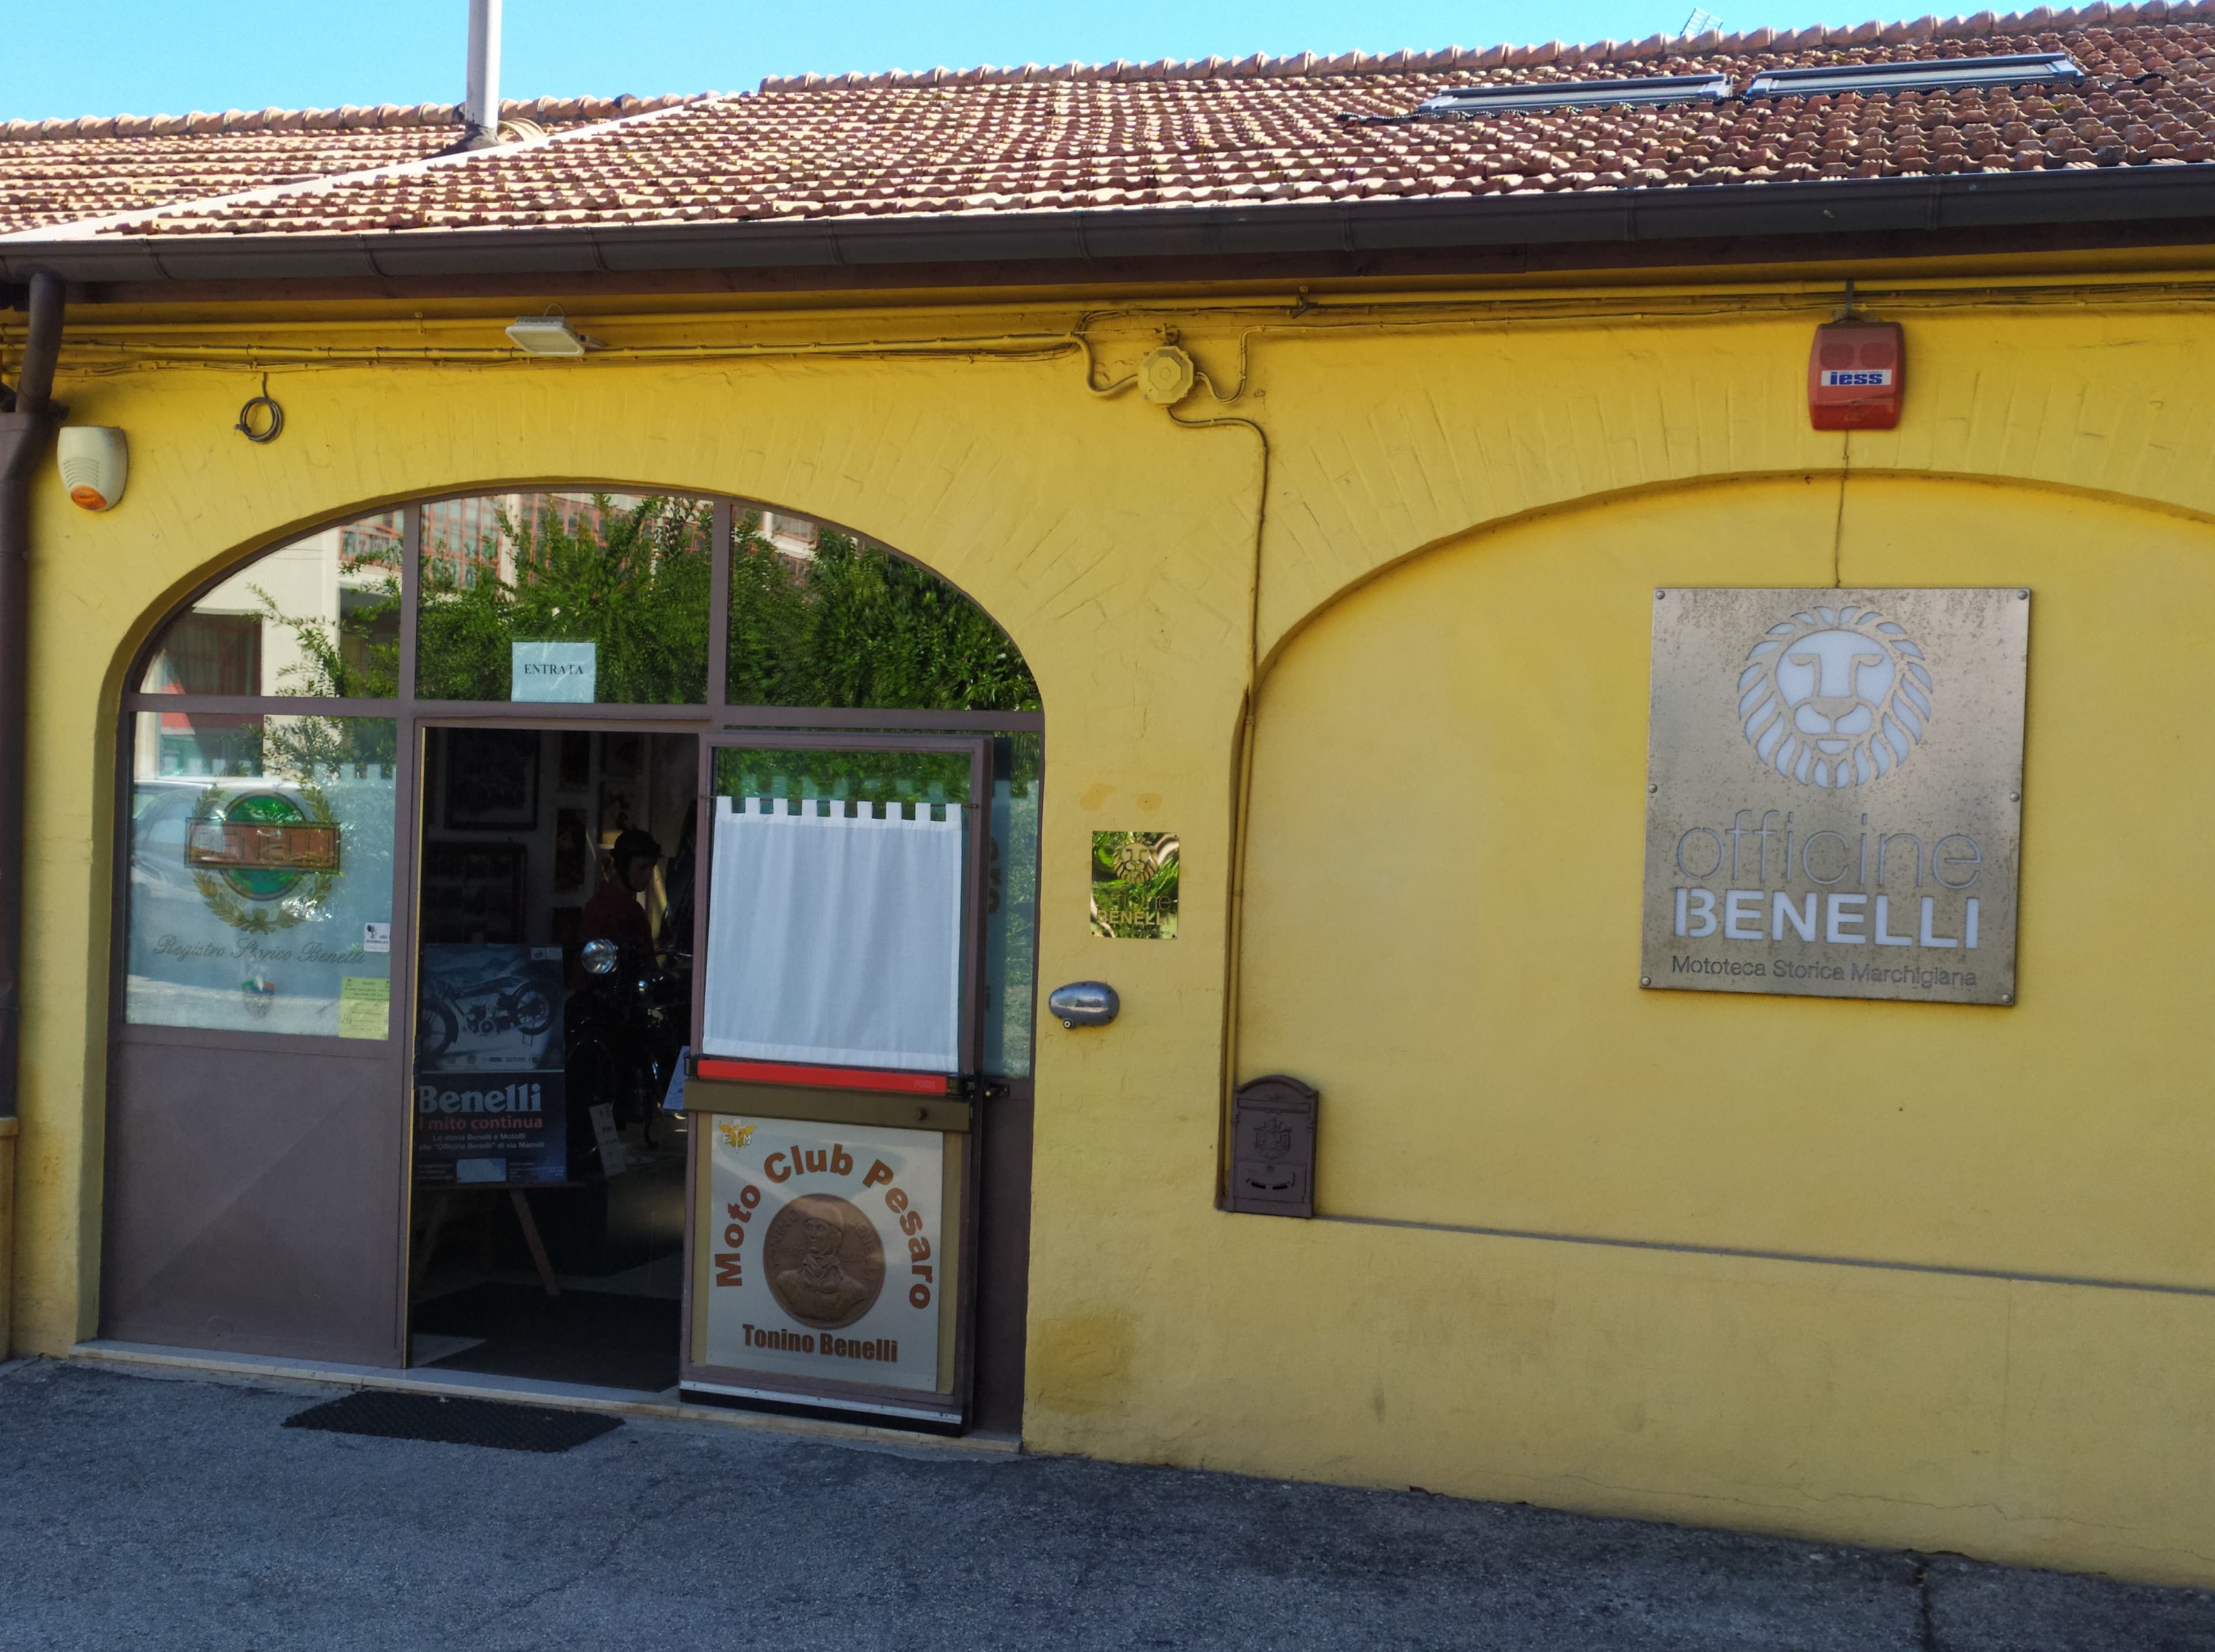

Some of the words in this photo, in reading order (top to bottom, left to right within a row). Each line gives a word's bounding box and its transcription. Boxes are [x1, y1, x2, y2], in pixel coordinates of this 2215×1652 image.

[1830, 371, 1883, 385] iess
[524, 664, 584, 674] ENTRATA
[1676, 809, 1982, 890] officine
[1674, 887, 1980, 949] BENELLI
[153, 934, 226, 962] Registro
[231, 937, 292, 960] Storico
[296, 941, 366, 965] Benelli
[1672, 955, 1767, 977] Mototeca
[1773, 959, 1845, 980] Storica
[1851, 963, 1978, 989] Marchigiana
[419, 1083, 542, 1114] Benelli
[429, 1116, 467, 1130] mito
[471, 1114, 543, 1130] continua
[715, 1184, 761, 1287] Moto
[764, 1143, 854, 1184] Club
[862, 1158, 933, 1309] Pesaro
[742, 1323, 814, 1354] Tonino
[819, 1332, 898, 1363] Benelli
